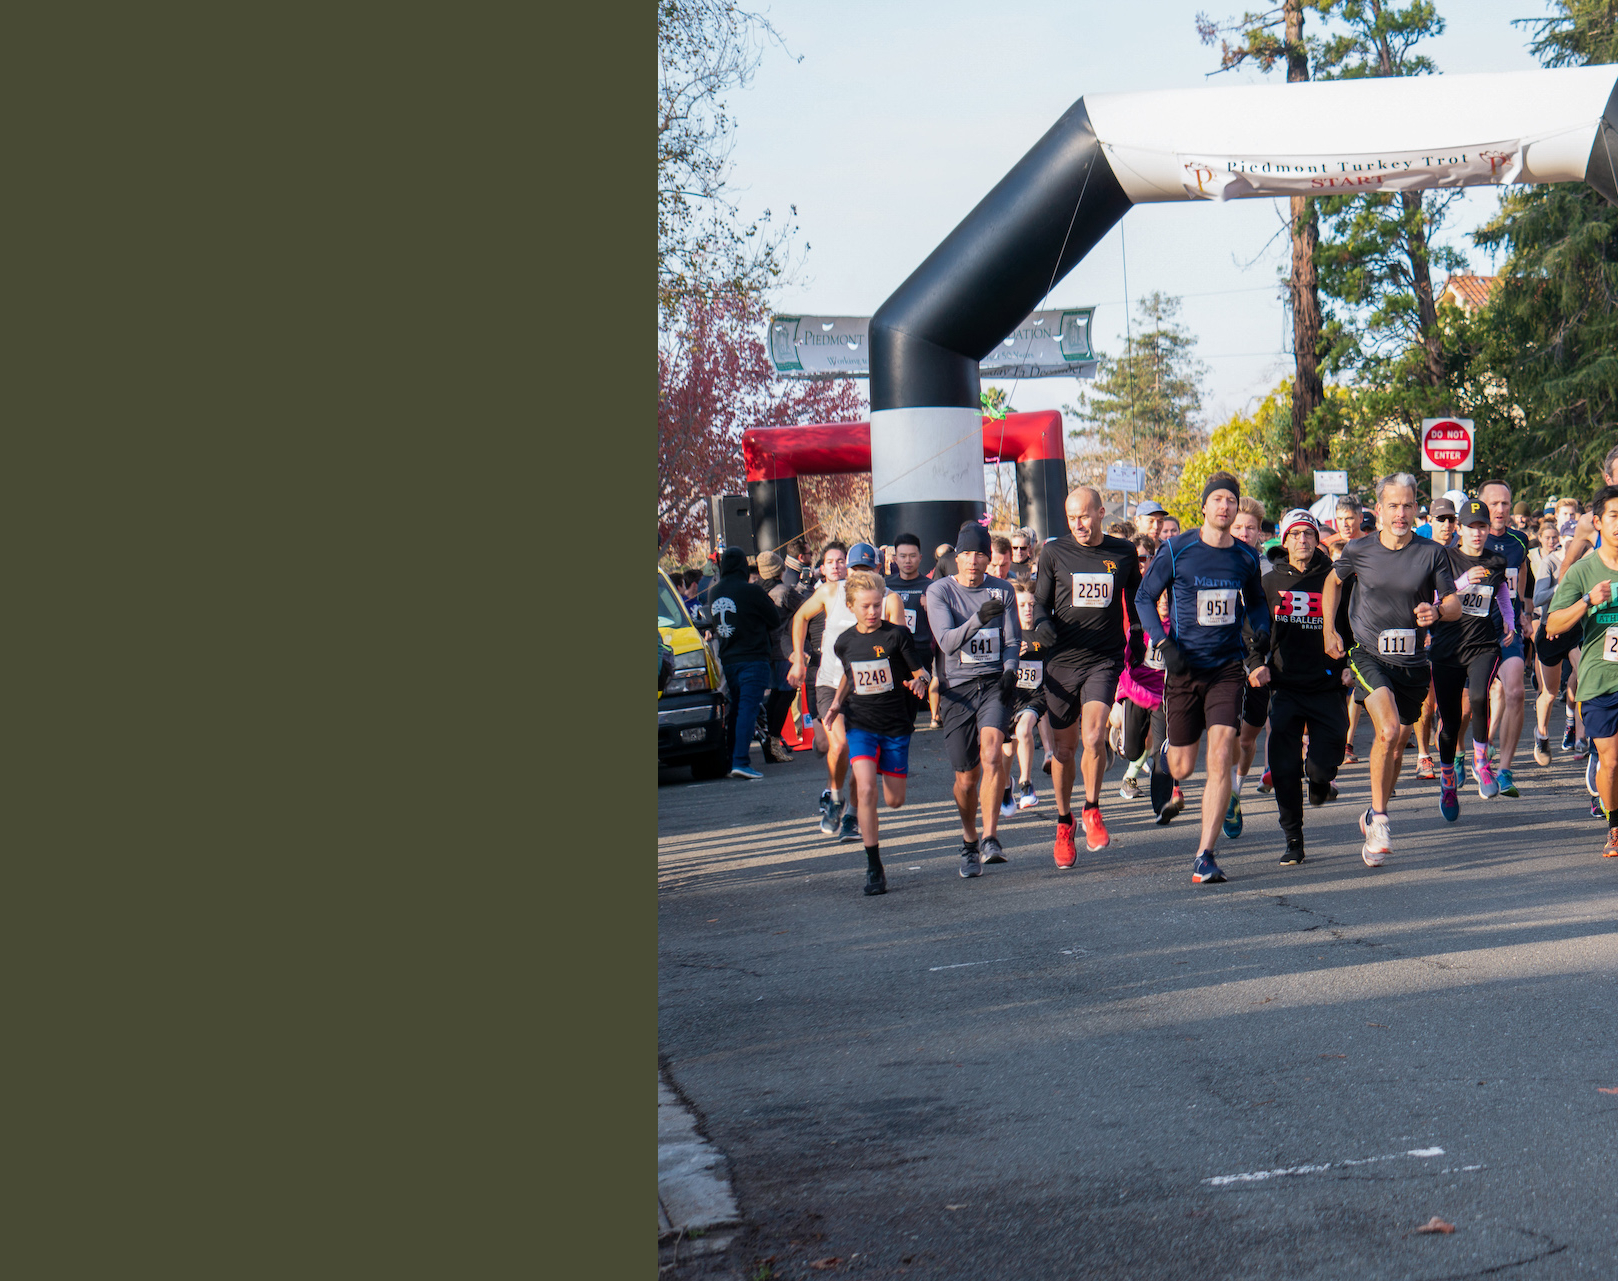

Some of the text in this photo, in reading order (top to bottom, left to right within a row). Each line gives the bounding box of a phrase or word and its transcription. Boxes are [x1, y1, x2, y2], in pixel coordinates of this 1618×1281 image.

[1227, 153, 1468, 173] Piedmont Turkey Trot
[1311, 174, 1386, 189] START
[804, 330, 865, 346] PIEDMONT
[1431, 430, 1464, 439] DO NOT
[1434, 451, 1461, 460] ENTER
[1194, 575, 1241, 588] Marmot
[1078, 583, 1109, 598] 2250
[1207, 600, 1229, 616] 951
[1463, 593, 1483, 608] 820
[1275, 614, 1324, 625] BIG BALLER
[970, 638, 993, 654] 641
[1383, 636, 1406, 653] 111
[857, 669, 887, 687] 2248
